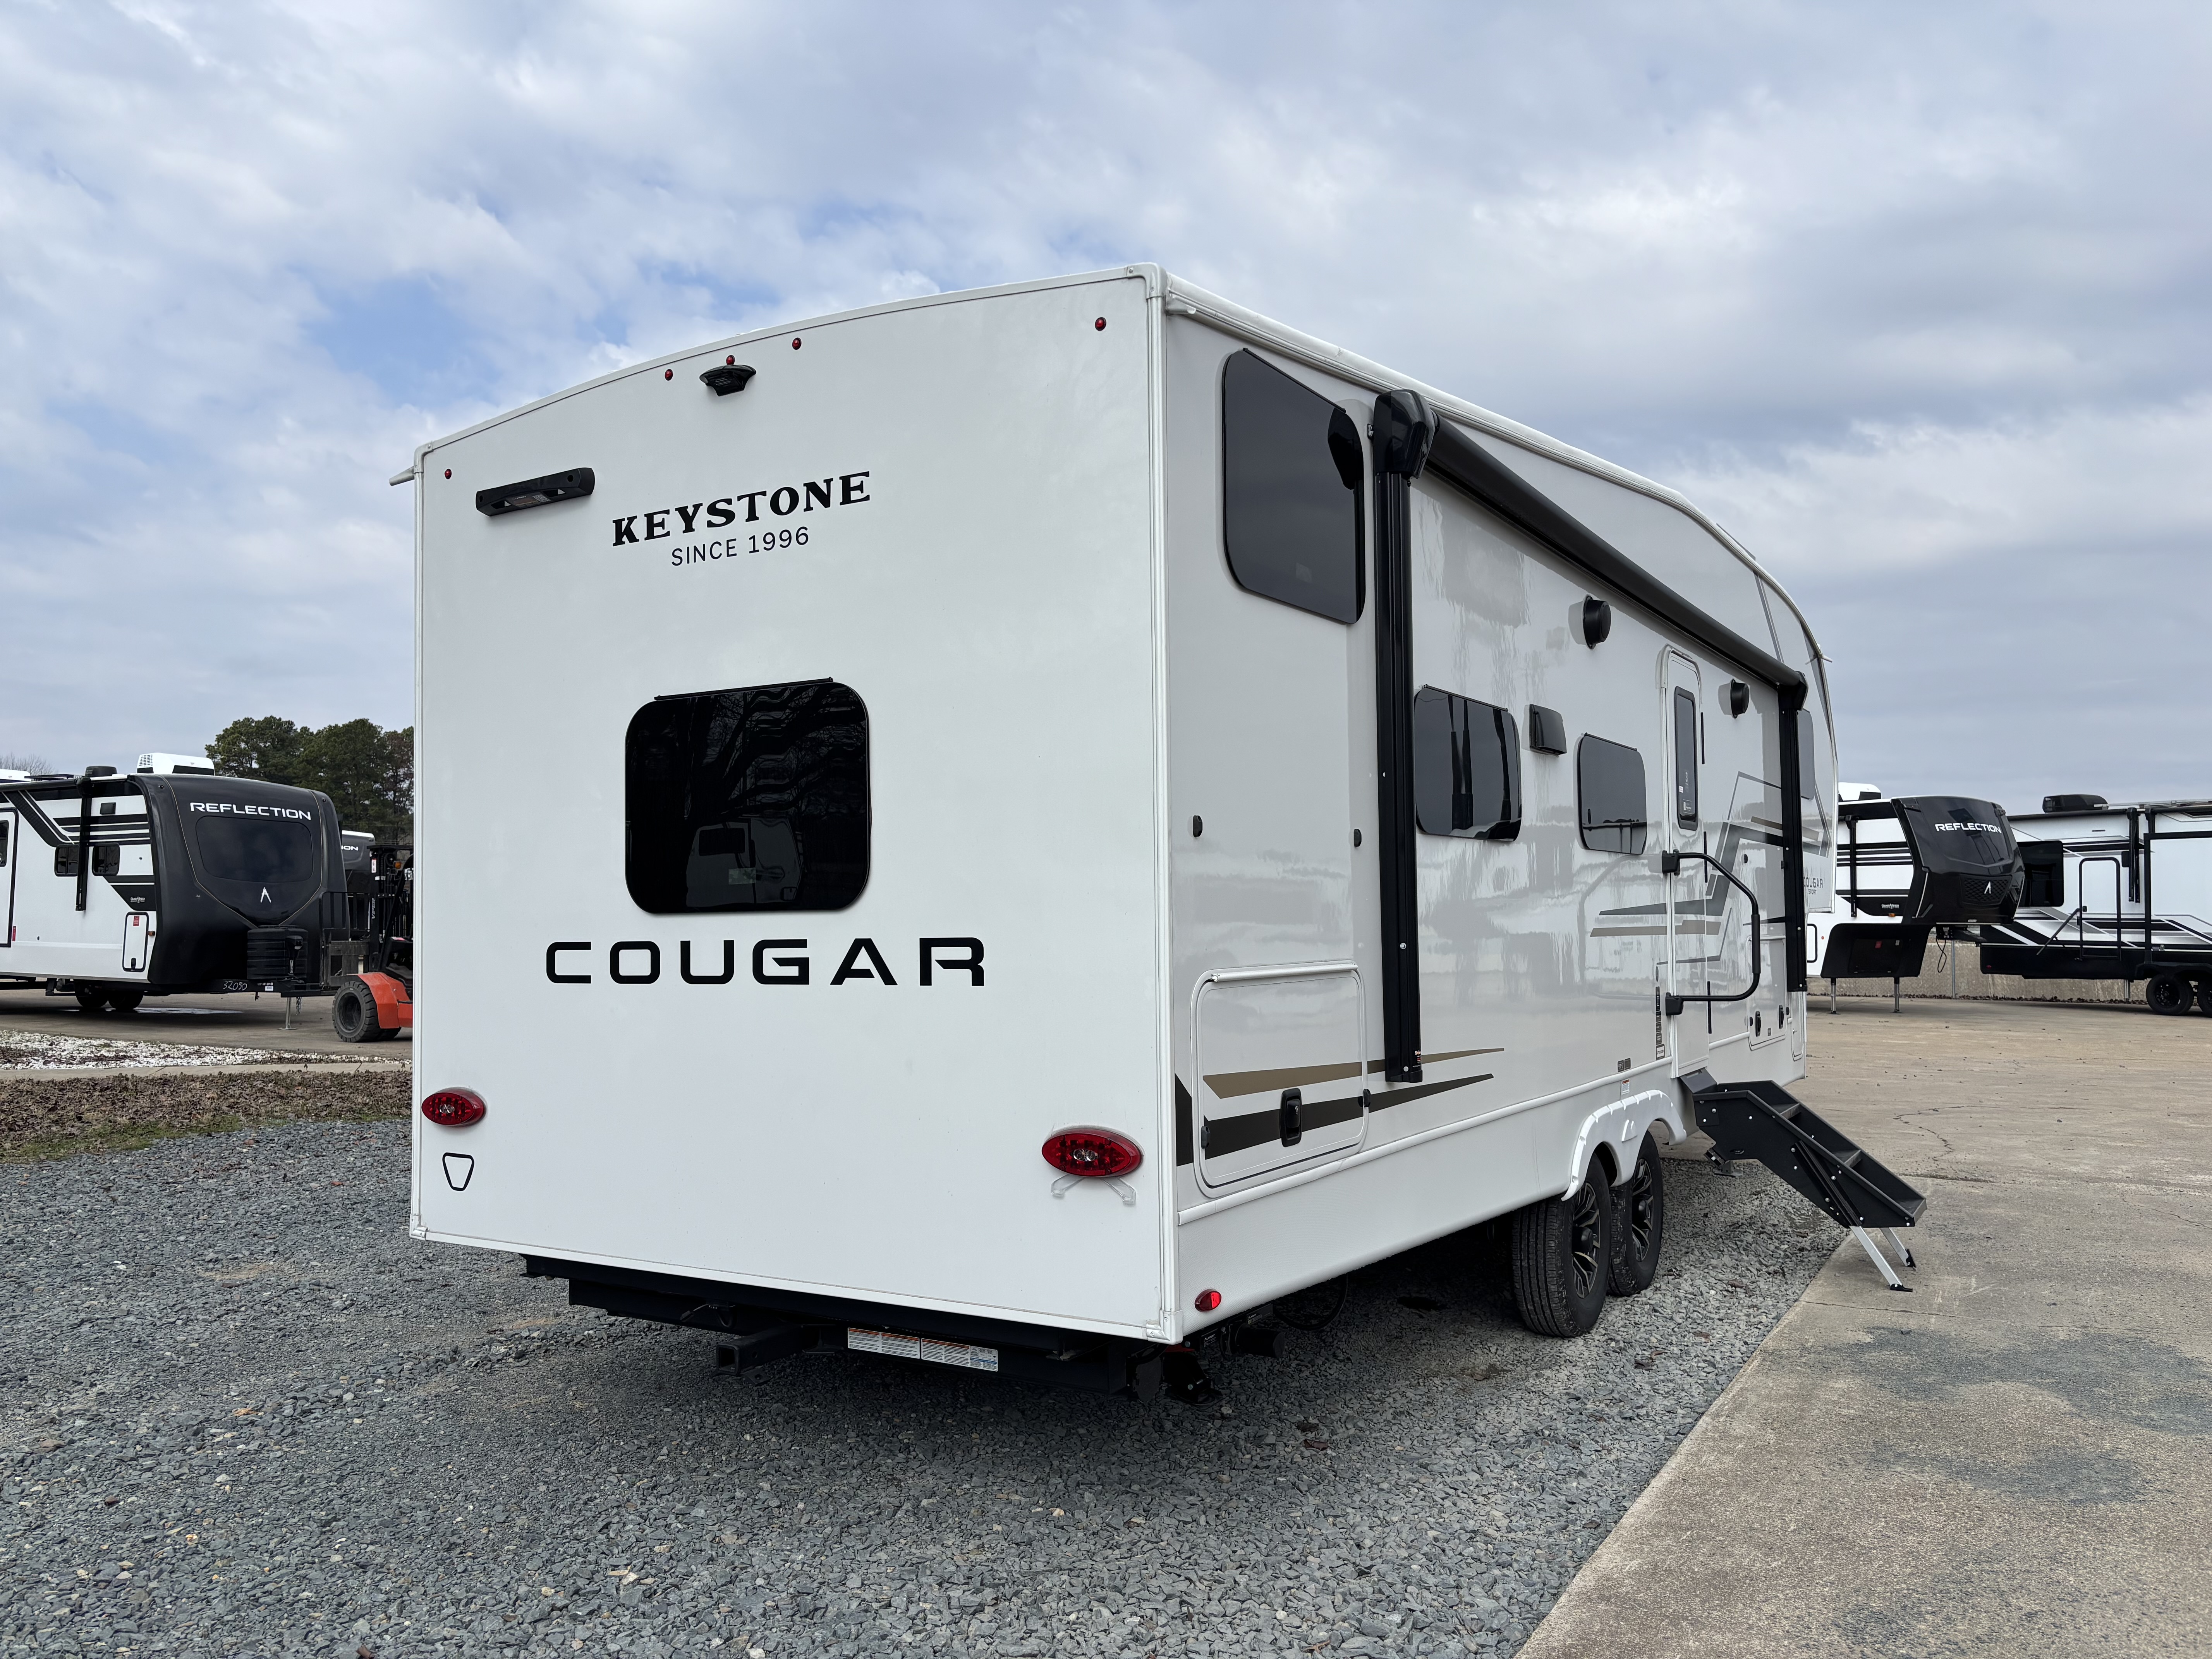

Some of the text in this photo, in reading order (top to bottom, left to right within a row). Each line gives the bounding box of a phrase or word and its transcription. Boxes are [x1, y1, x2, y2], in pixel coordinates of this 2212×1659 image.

[612, 471, 870, 546] KEYSTONE
[672, 526, 809, 567] SINCE 1996
[190, 802, 311, 821] REFLECTION
[1935, 823, 2002, 834] REFLECTION
[546, 937, 984, 986] COUGAR
[223, 980, 248, 991] 32050
